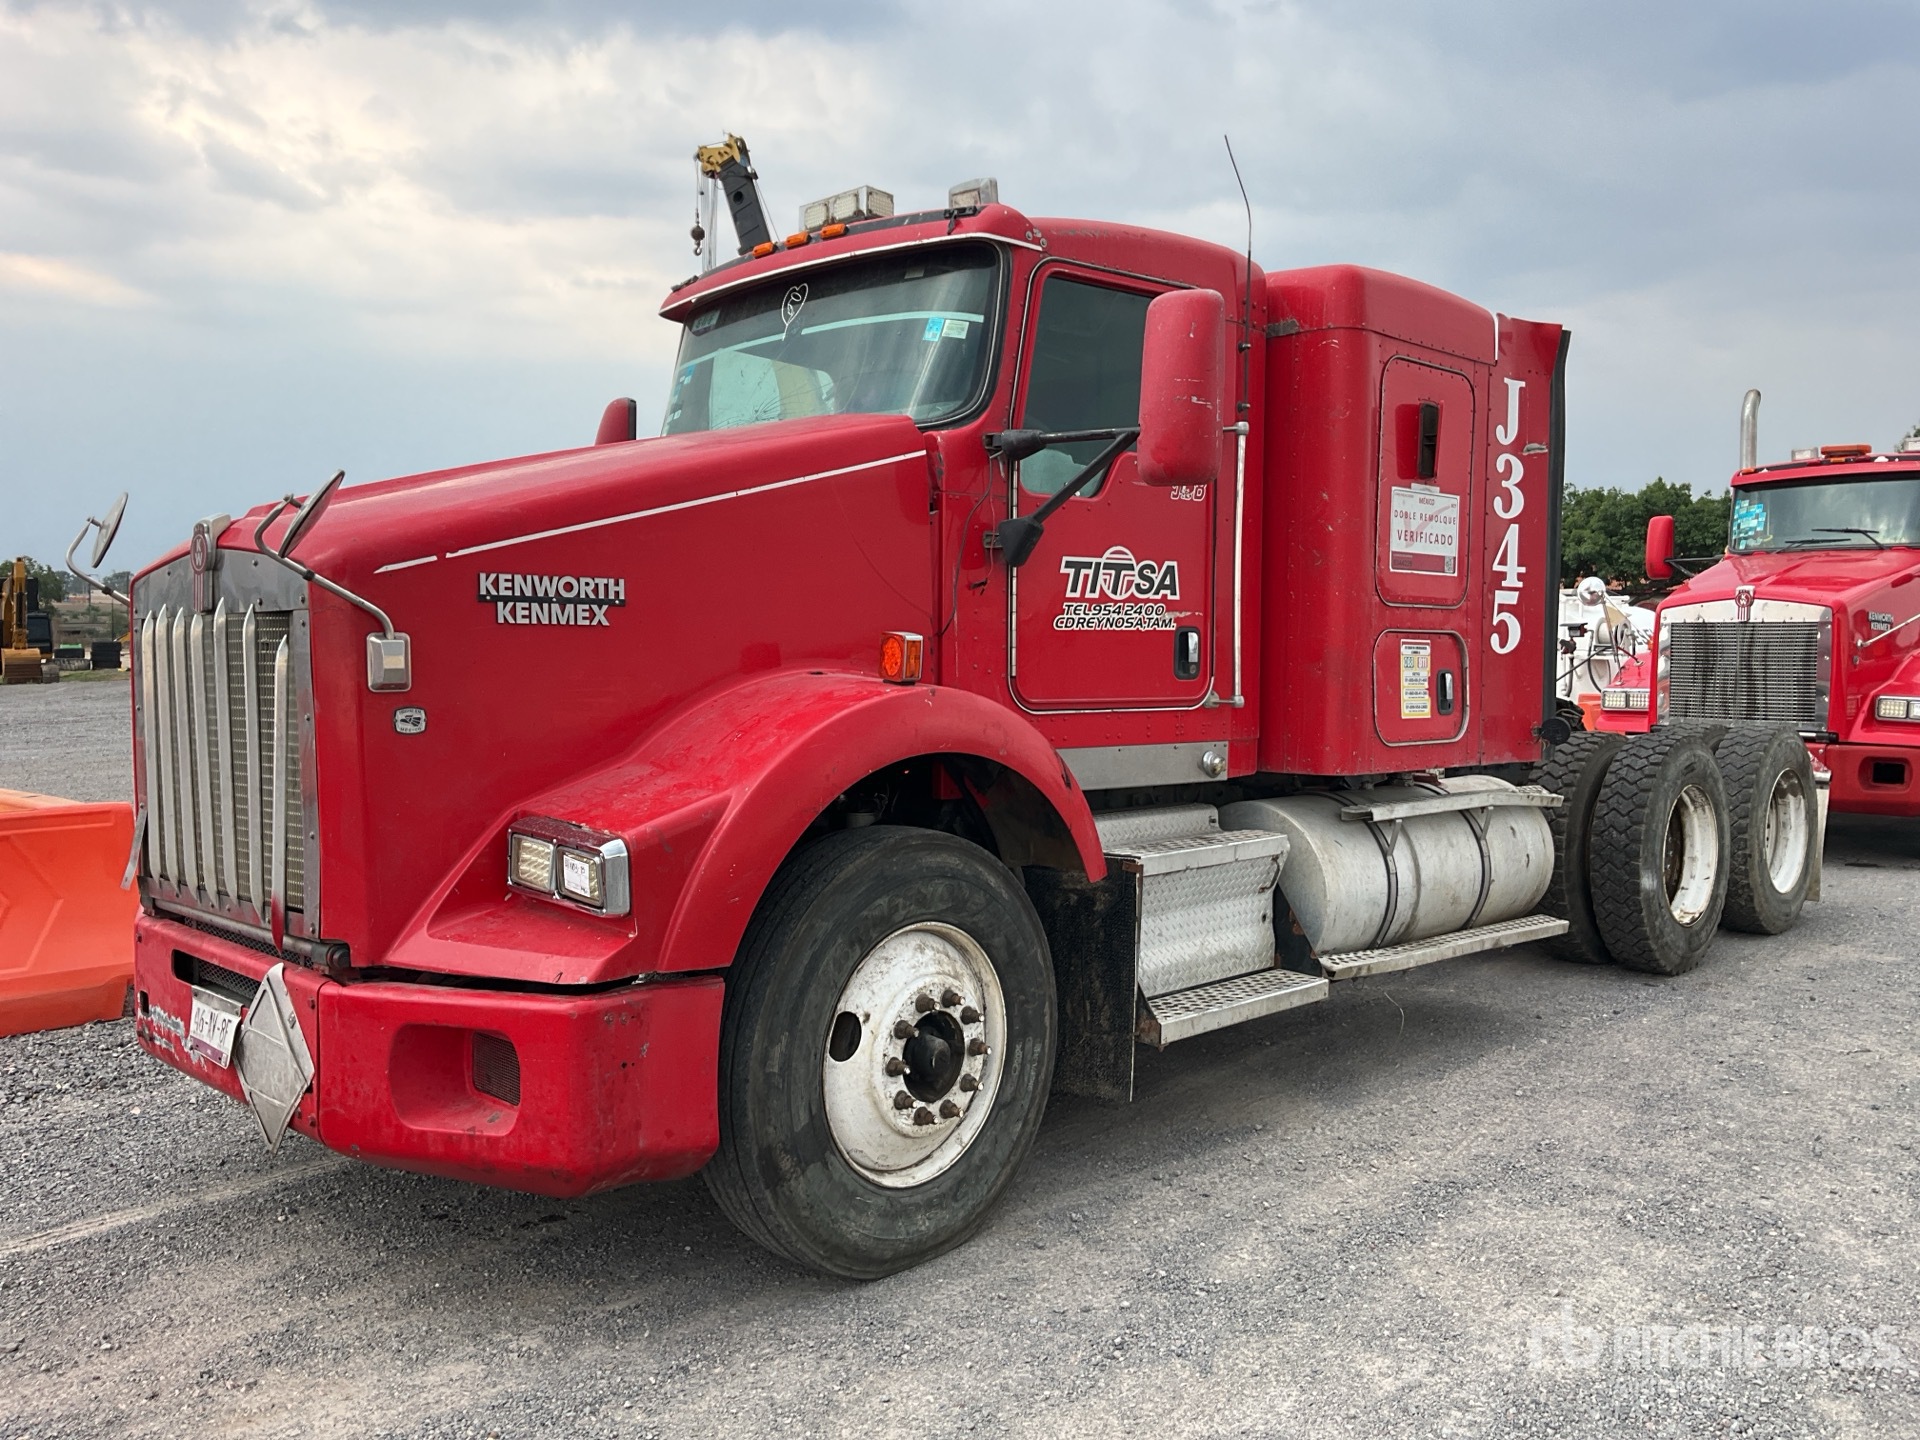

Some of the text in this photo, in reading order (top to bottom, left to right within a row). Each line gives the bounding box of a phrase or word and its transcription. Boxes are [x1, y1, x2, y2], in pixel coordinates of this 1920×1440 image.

[1394, 509, 1456, 525] DOBLE REMOLQUE
[1490, 377, 1526, 654] J345
[1397, 529, 1453, 546] VERIFICADO
[479, 572, 625, 600] KENWORTH
[1060, 554, 1180, 600] TITSA
[497, 601, 610, 626] KENMEX
